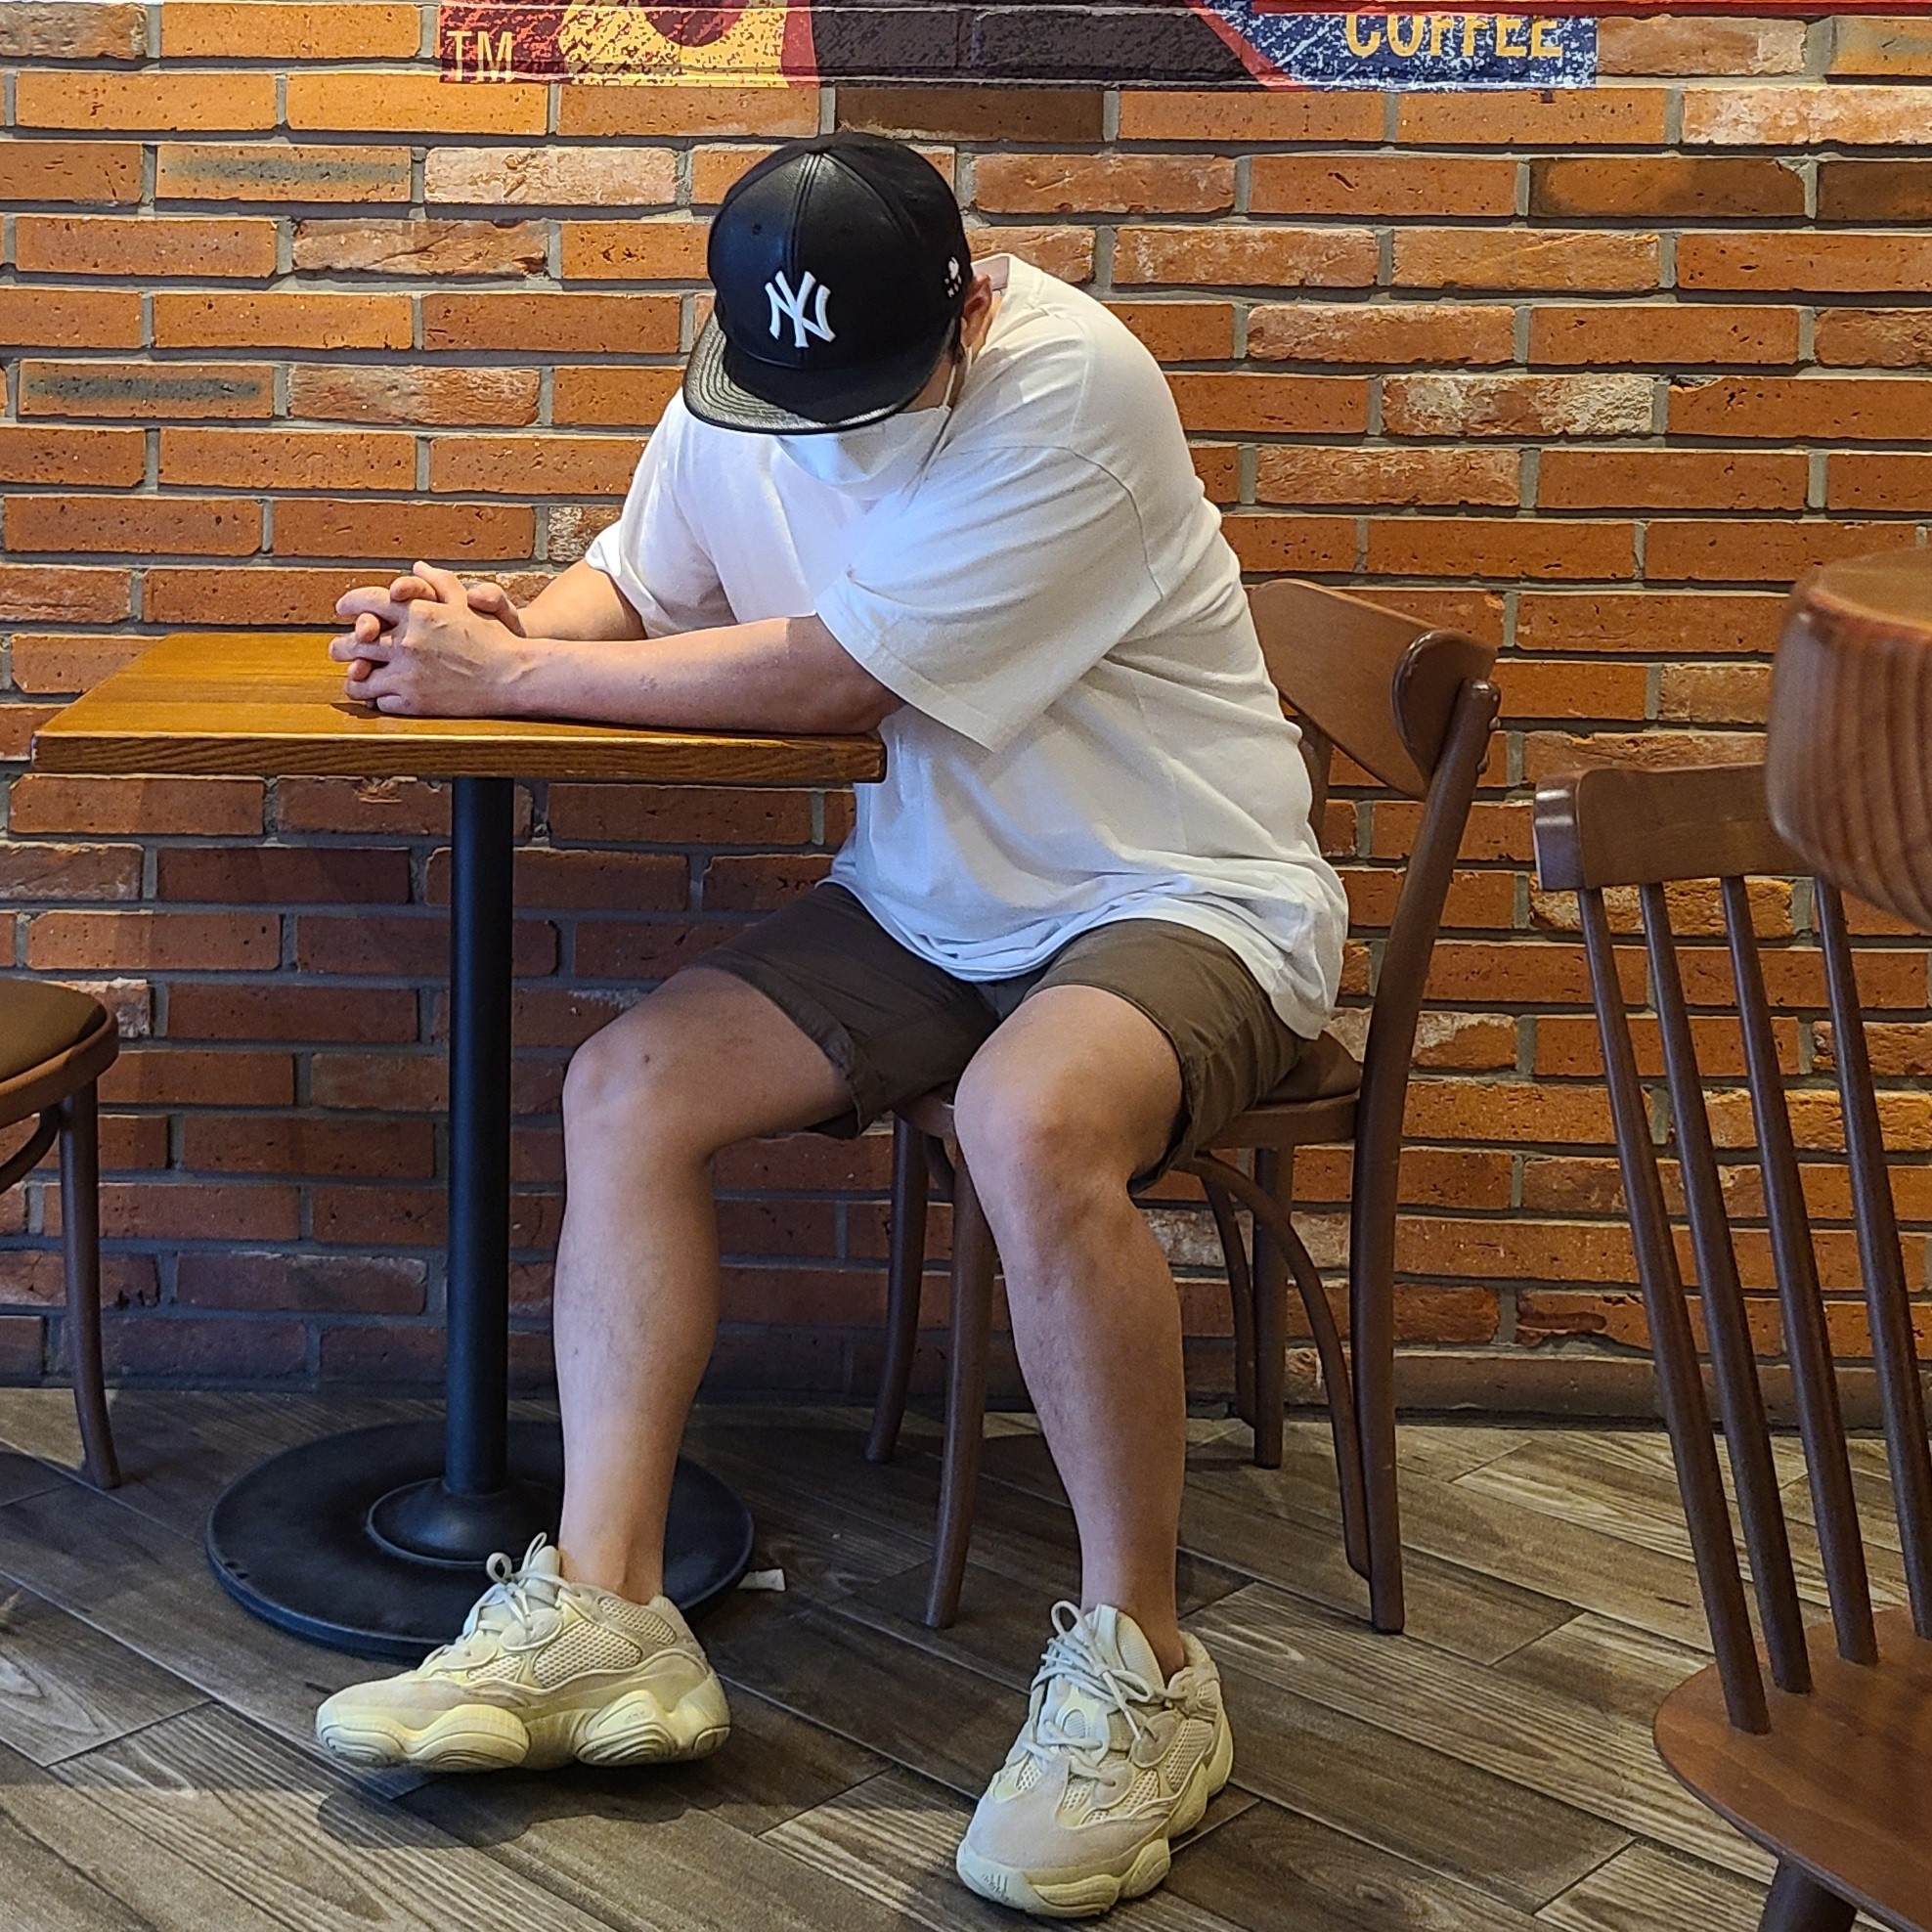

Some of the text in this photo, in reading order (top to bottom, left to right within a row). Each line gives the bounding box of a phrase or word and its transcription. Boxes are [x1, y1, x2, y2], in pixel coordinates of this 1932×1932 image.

[446, 30, 512, 82] TM
[1345, 14, 1562, 58] COFFEE
[765, 270, 836, 348] NY
